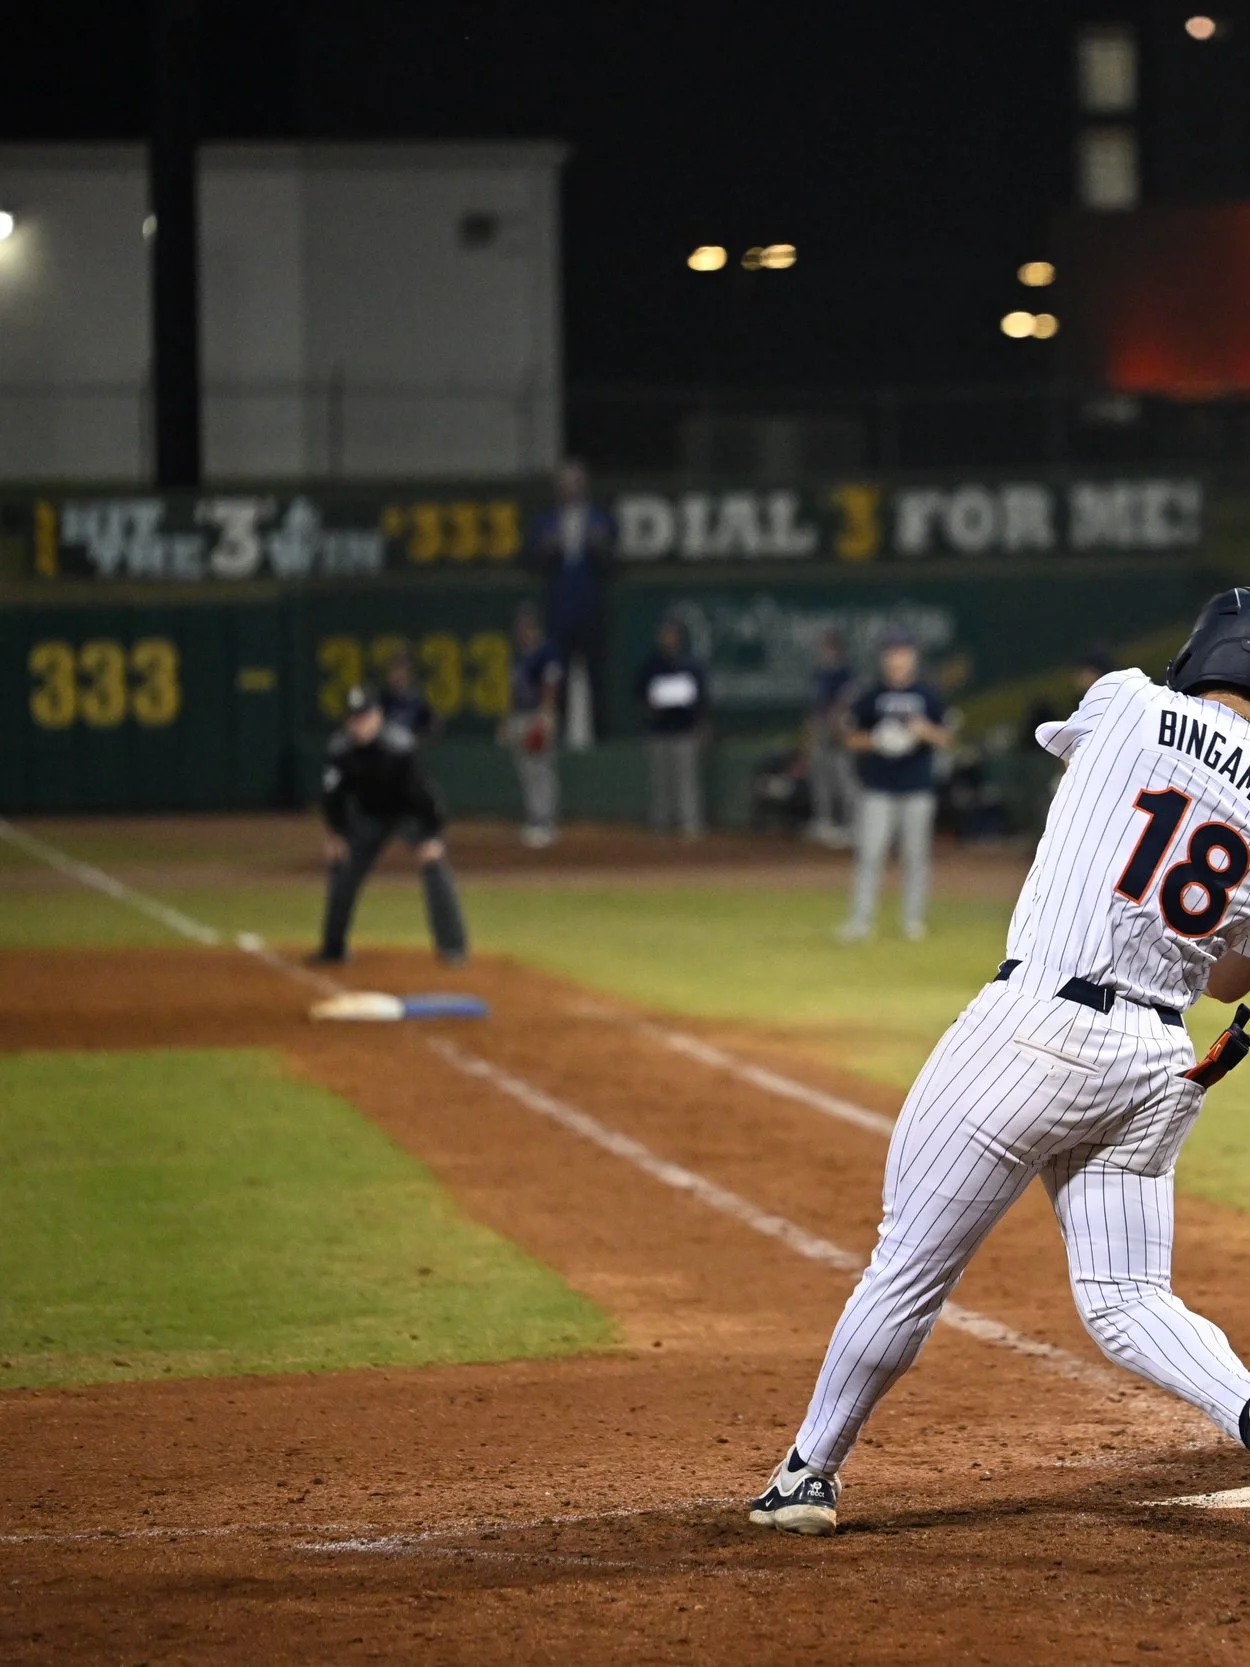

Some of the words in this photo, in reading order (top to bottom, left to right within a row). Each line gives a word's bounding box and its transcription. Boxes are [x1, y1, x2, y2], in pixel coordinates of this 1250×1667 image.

[618, 493, 816, 560] DIAL
[834, 484, 880, 561] 3
[896, 484, 1058, 556] FOR
[28, 636, 182, 729] 333
[1113, 786, 1250, 938] 18
